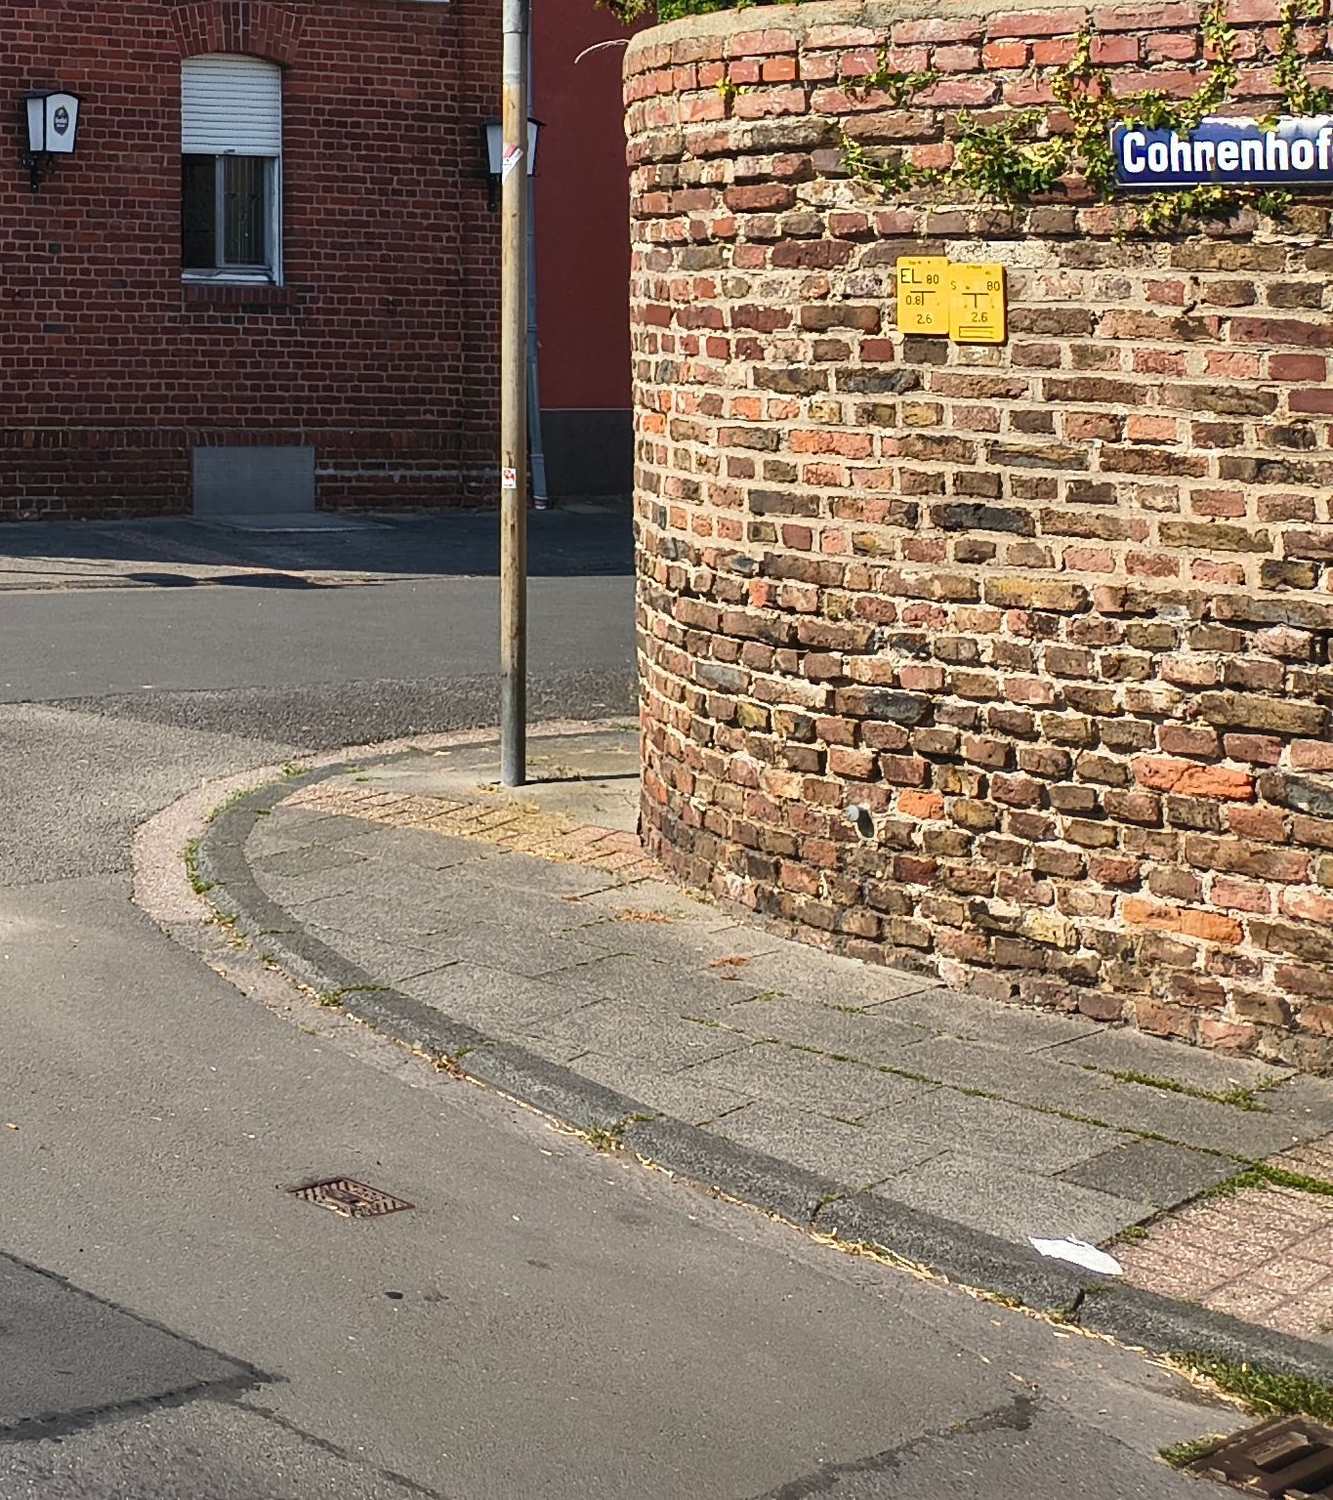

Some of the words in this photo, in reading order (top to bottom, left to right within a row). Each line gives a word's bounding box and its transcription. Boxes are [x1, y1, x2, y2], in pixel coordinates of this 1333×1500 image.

[1123, 128, 1333, 173] Cohnenhof
[900, 268, 922, 284] EL
[926, 274, 940, 285] 80
[986, 280, 1001, 291] 80
[905, 294, 921, 305] 0.8
[916, 314, 933, 324] 2.6
[971, 311, 988, 323] 2.6
